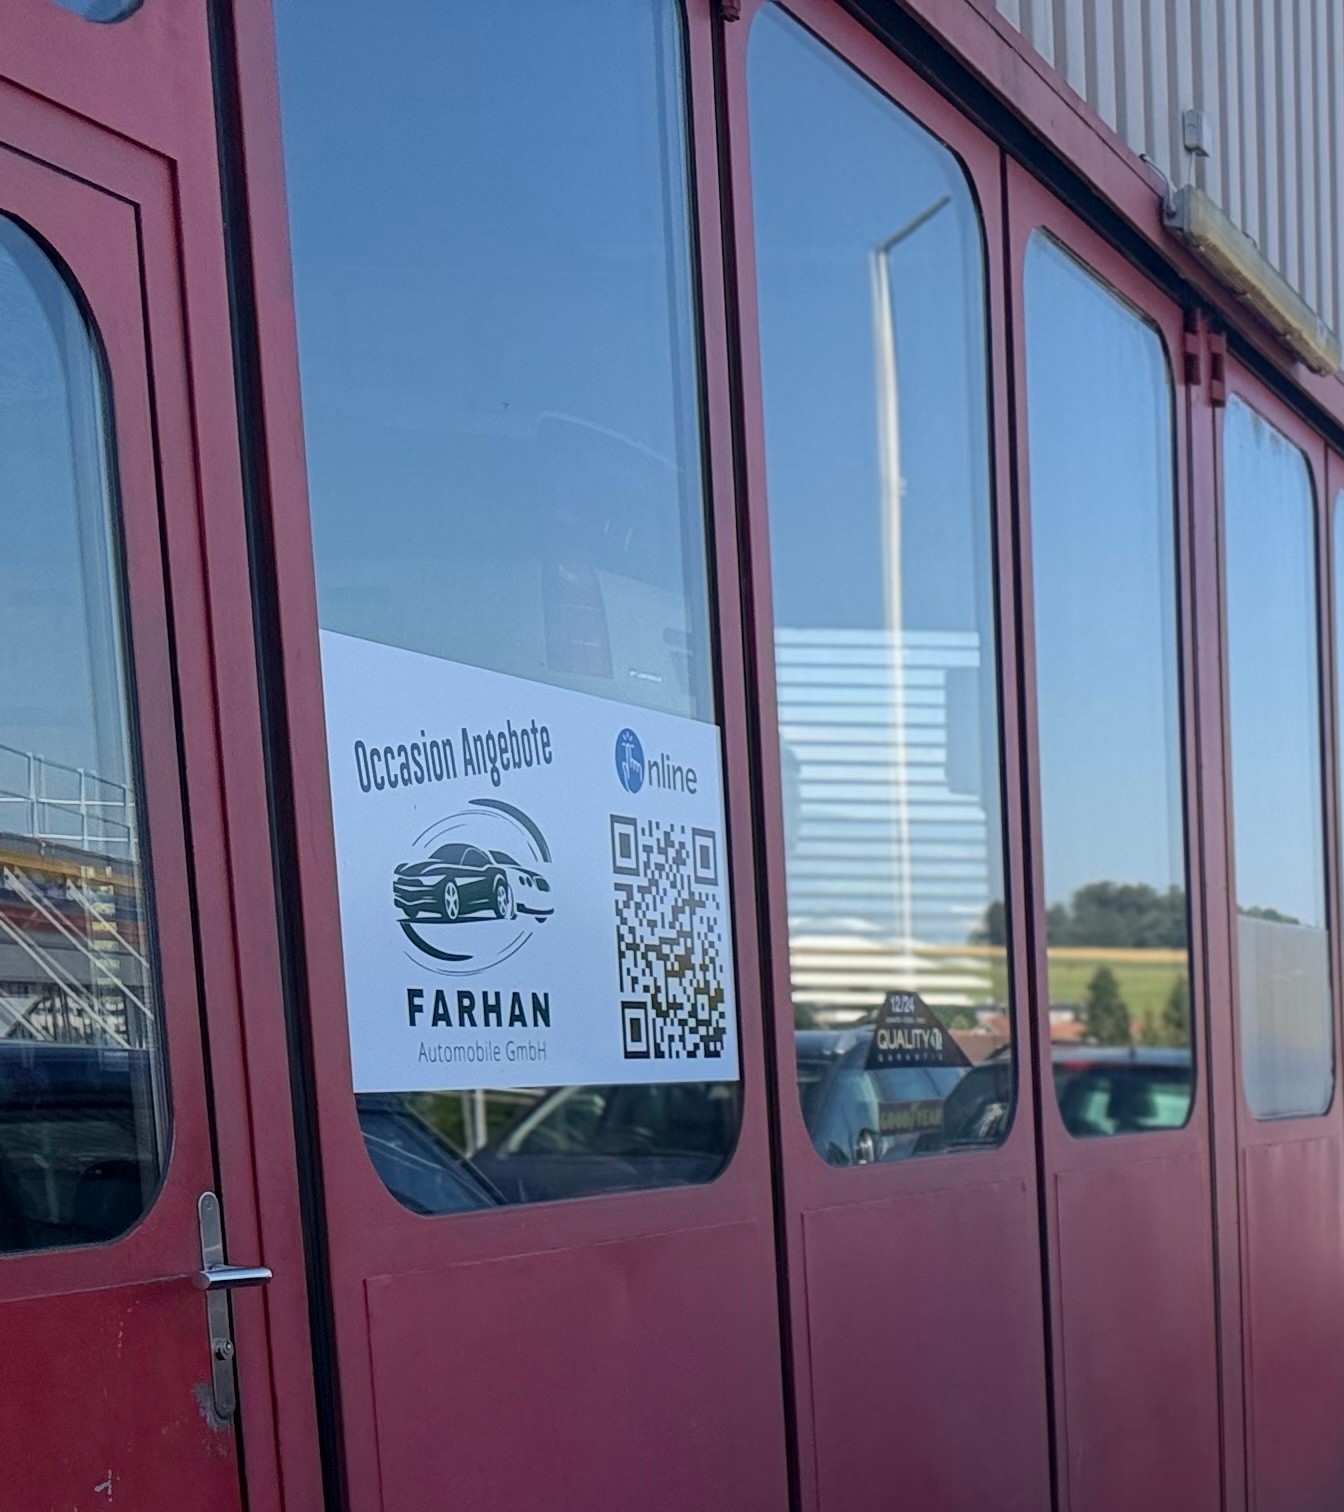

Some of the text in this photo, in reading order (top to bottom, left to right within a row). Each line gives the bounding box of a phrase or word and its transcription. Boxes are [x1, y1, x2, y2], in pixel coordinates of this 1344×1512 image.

[354, 719, 553, 793] Occasion Angebote
[406, 988, 551, 1028] FARHAN
[418, 1040, 547, 1063] Automobile GmbH
